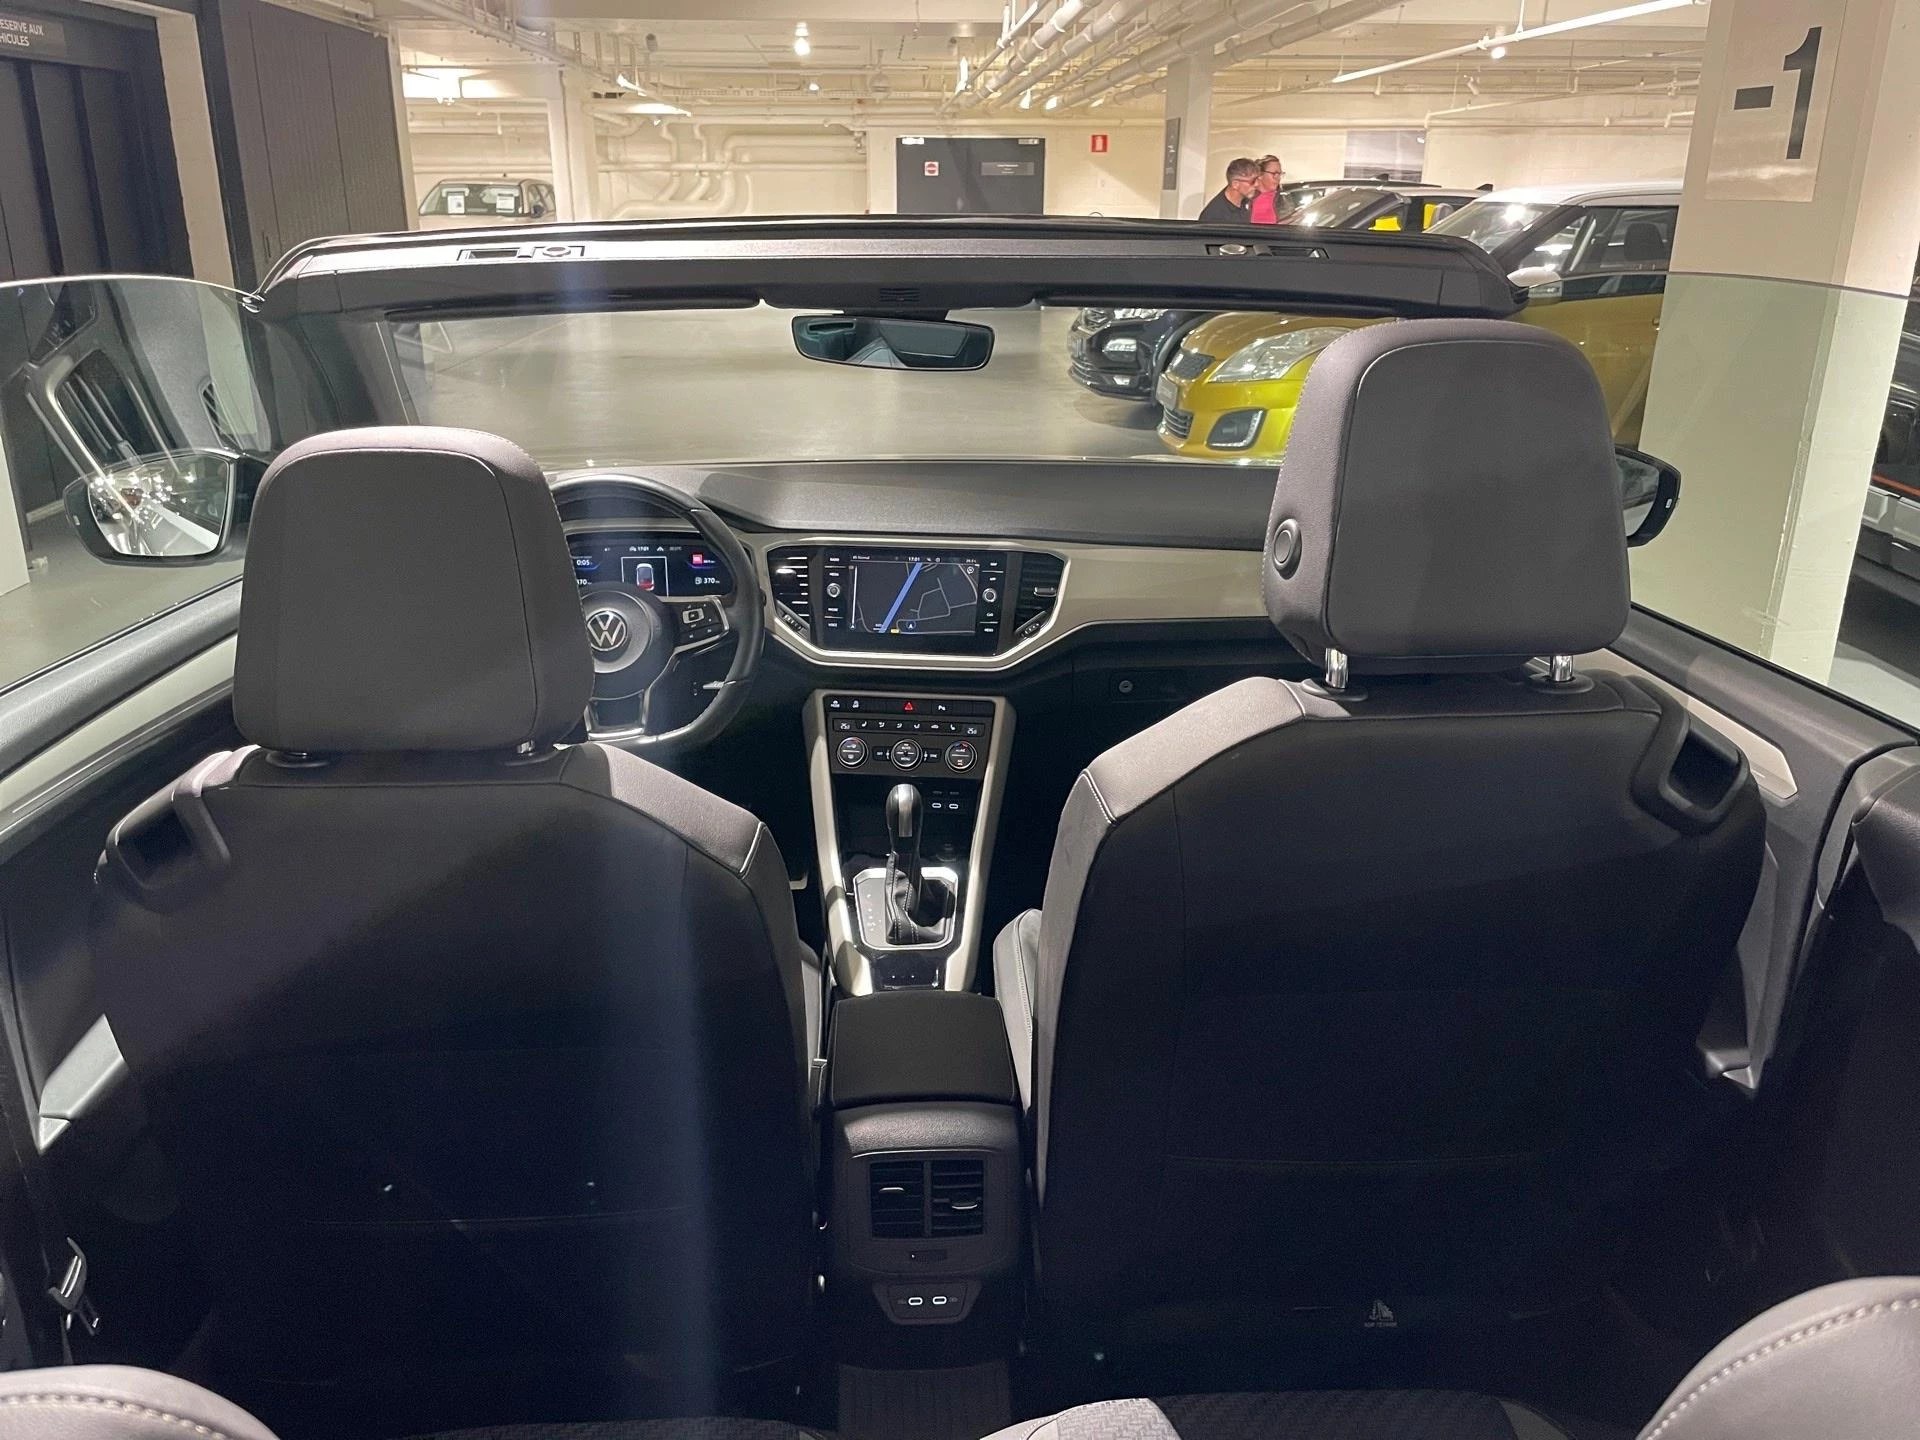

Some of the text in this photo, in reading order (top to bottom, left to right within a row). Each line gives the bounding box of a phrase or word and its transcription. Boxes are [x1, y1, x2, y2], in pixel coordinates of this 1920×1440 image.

[0, 18, 44, 36] ESERVE AUX
[1733, 26, 1822, 160] -1
